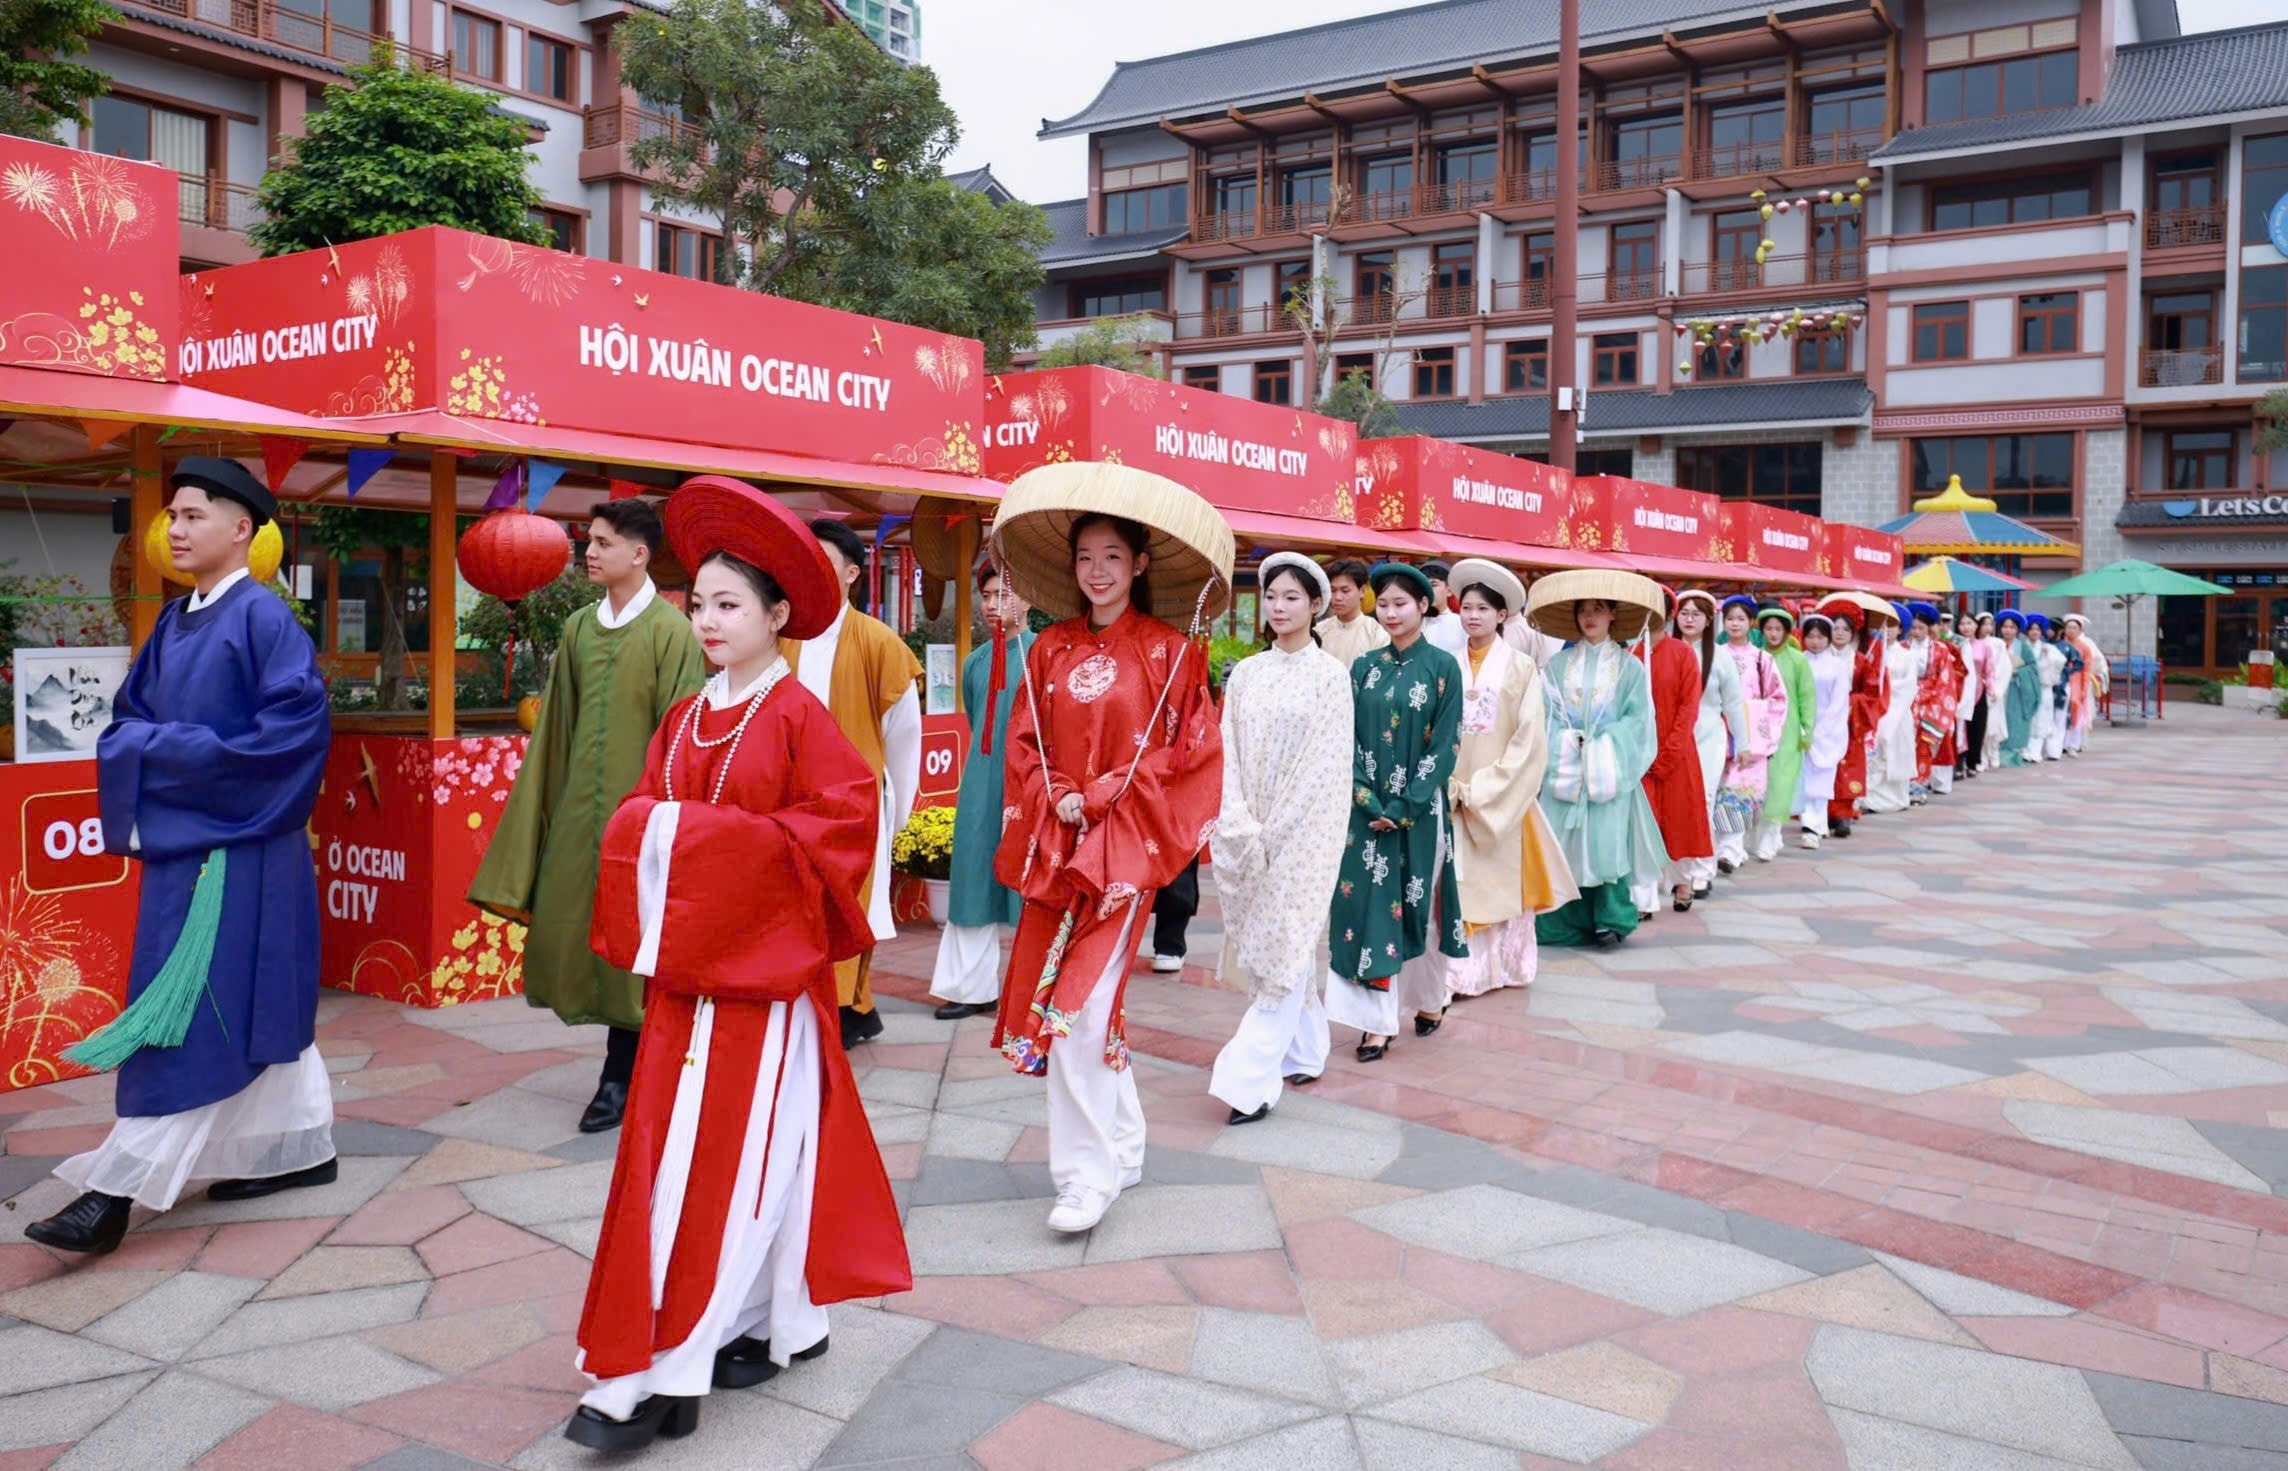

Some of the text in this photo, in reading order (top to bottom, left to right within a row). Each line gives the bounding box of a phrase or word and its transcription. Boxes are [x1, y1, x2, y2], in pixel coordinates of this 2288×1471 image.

[206, 328, 257, 371] XUÂN
[262, 321, 326, 363] OCEAN
[332, 313, 378, 353] CITY
[579, 322, 891, 412] HỘI XUÂN OCEAN CITY
[996, 420, 1039, 447] CITY
[1155, 422, 1308, 476] HỘI XUÂN OCEAN CITY
[926, 749, 952, 775] 09
[44, 817, 105, 860] 08
[347, 844, 405, 881] OCEAN
[328, 879, 378, 924] CITY
